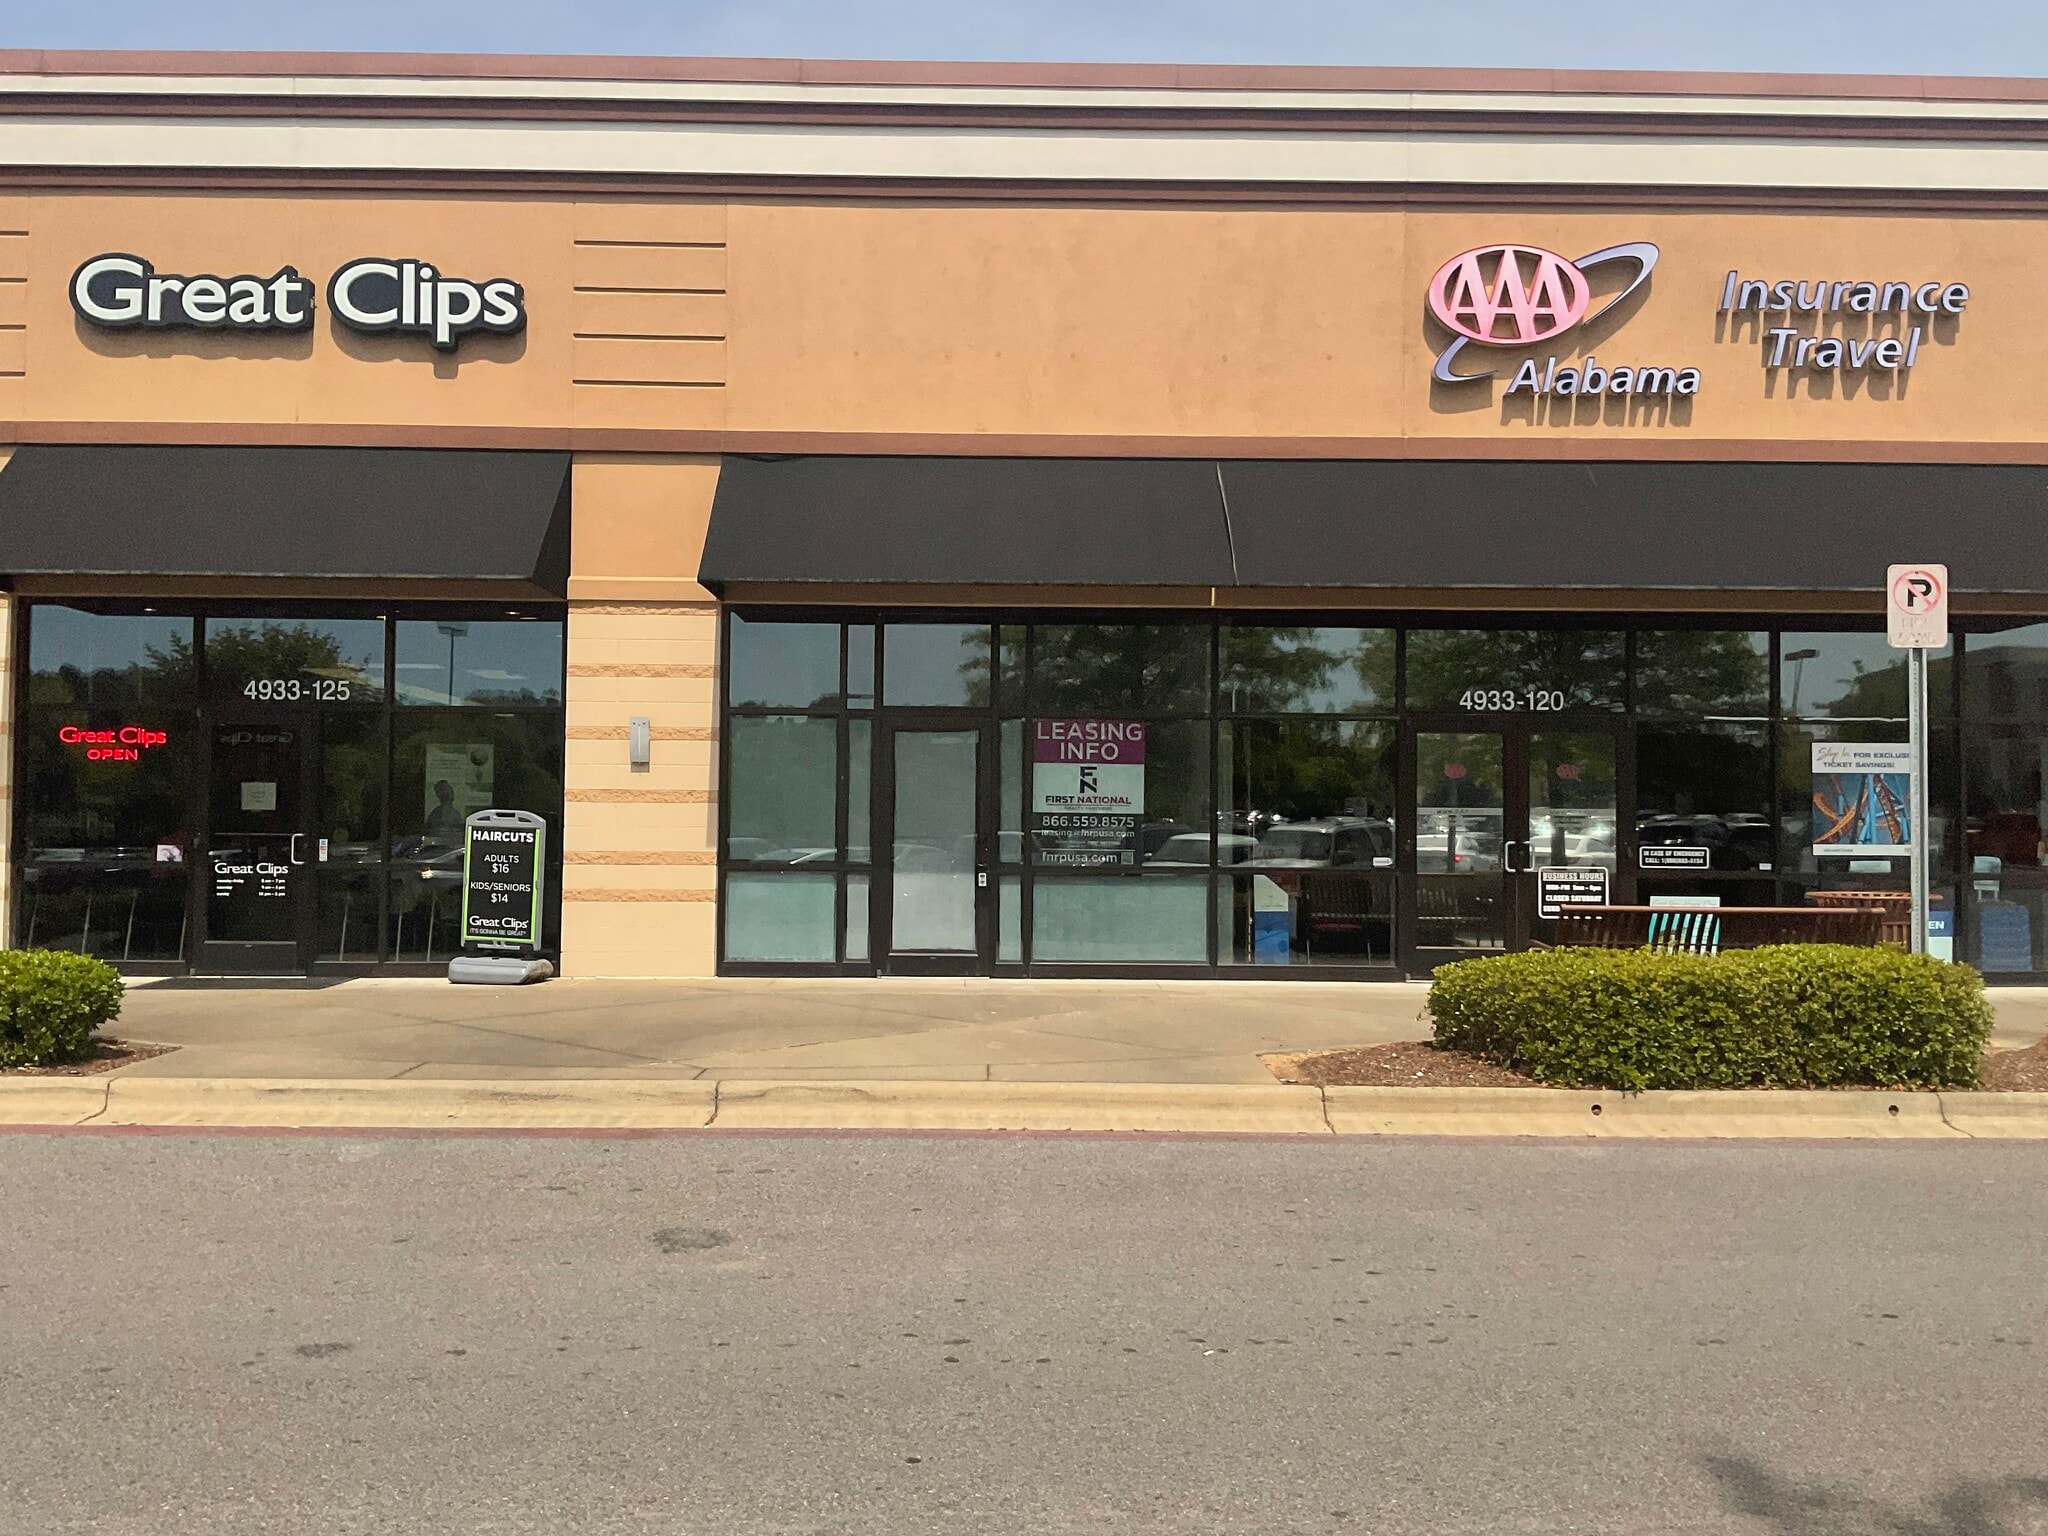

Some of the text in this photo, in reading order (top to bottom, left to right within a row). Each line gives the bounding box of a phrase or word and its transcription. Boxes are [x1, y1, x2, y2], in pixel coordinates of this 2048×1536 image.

[1444, 245, 1580, 341] AAA
[1721, 270, 1971, 314] Insurance
[74, 257, 519, 344] Great Clips
[1768, 326, 1921, 368] Travel
[1505, 356, 1700, 396] Alabama
[243, 680, 351, 700] 4933-125
[1459, 690, 1564, 711] 4933-120
[59, 726, 167, 748] Great Clips
[1037, 721, 1143, 741] LEASING
[86, 748, 138, 761] OPEN
[1060, 742, 1119, 761] INFO
[1045, 795, 1132, 805] FIRST NATIONAL
[1042, 815, 1135, 828] 866.559.8575
[472, 830, 535, 843] HAIRCUTS
[484, 854, 519, 863] ADULTS
[1042, 851, 1118, 864] fnrpusa.com
[214, 862, 289, 877] Great Clips
[491, 863, 510, 874] $16
[1543, 872, 1604, 881] BUSINESS HOURS
[470, 881, 531, 892] KIDS/SENIORS
[490, 892, 508, 904] $14
[469, 915, 528, 930] Great Clips
[1928, 920, 1945, 930] EN
